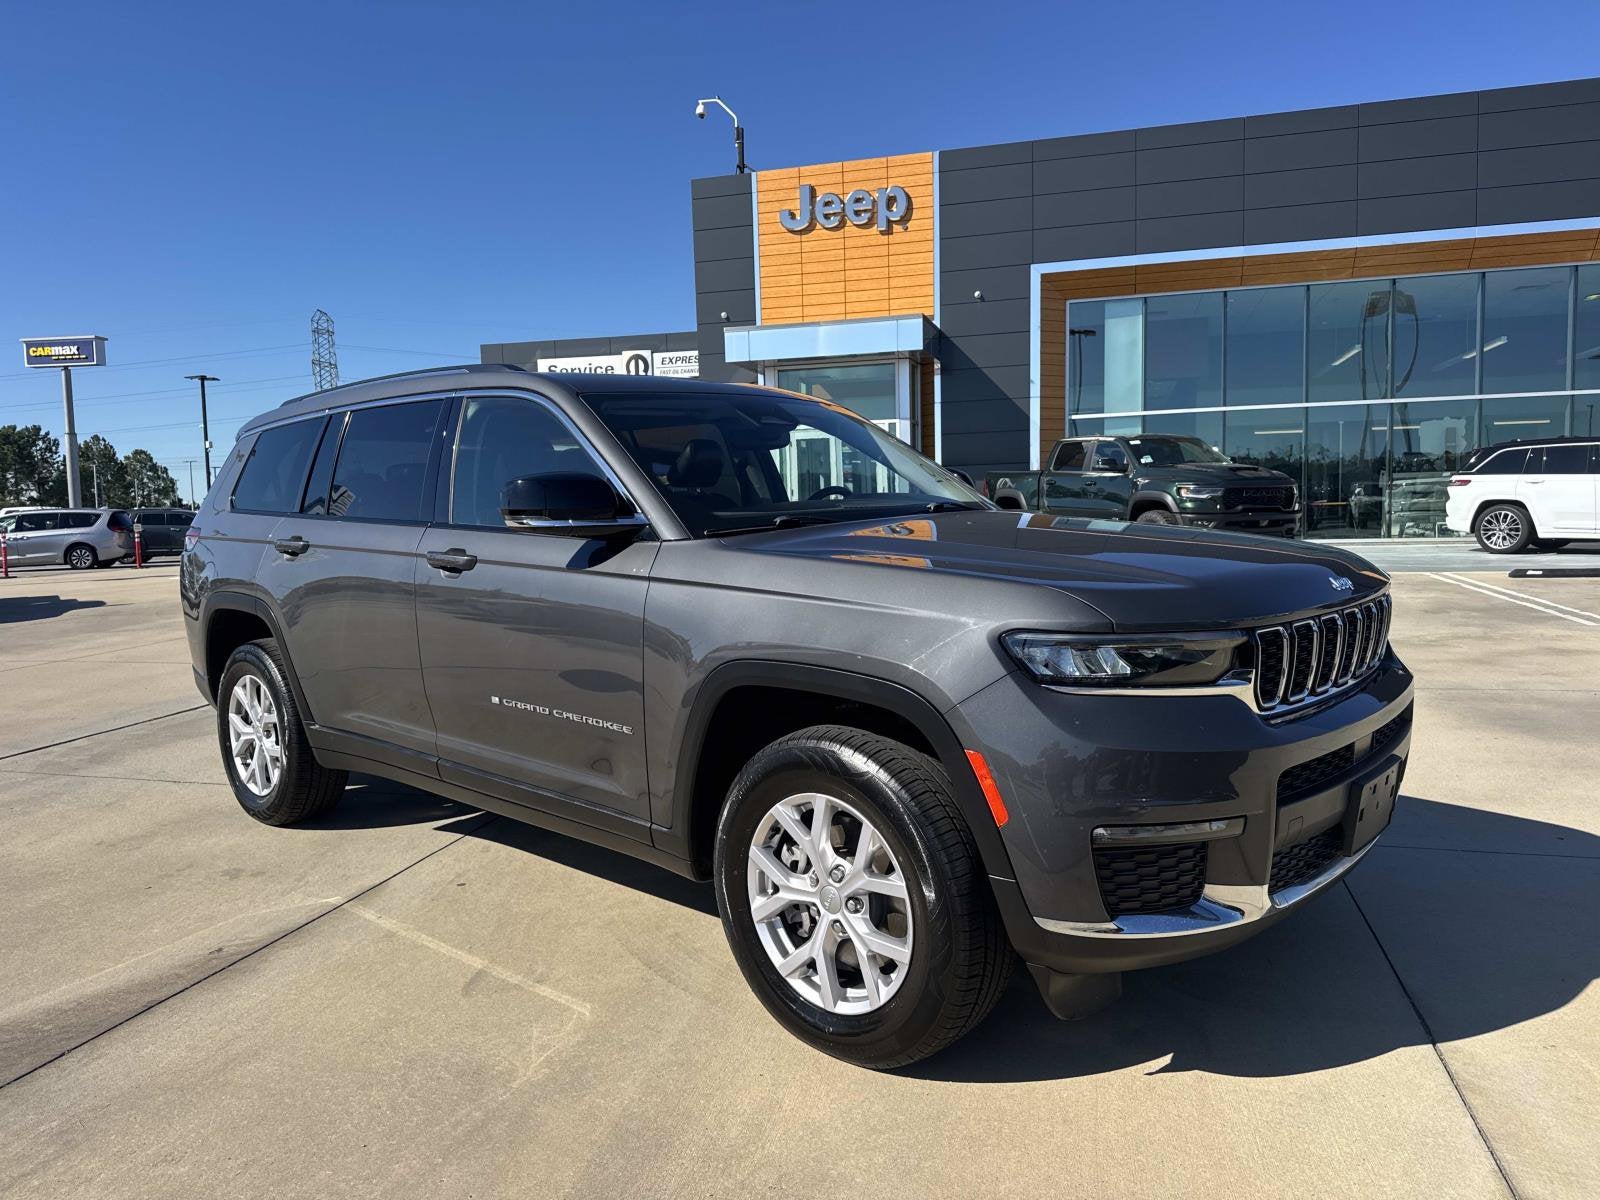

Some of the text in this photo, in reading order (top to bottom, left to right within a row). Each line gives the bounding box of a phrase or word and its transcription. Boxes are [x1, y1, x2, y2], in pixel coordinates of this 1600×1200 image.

[779, 184, 909, 232] Jeep
[1329, 577, 1354, 590] Jeep
[502, 698, 633, 735] GRAND CHEROKEE
